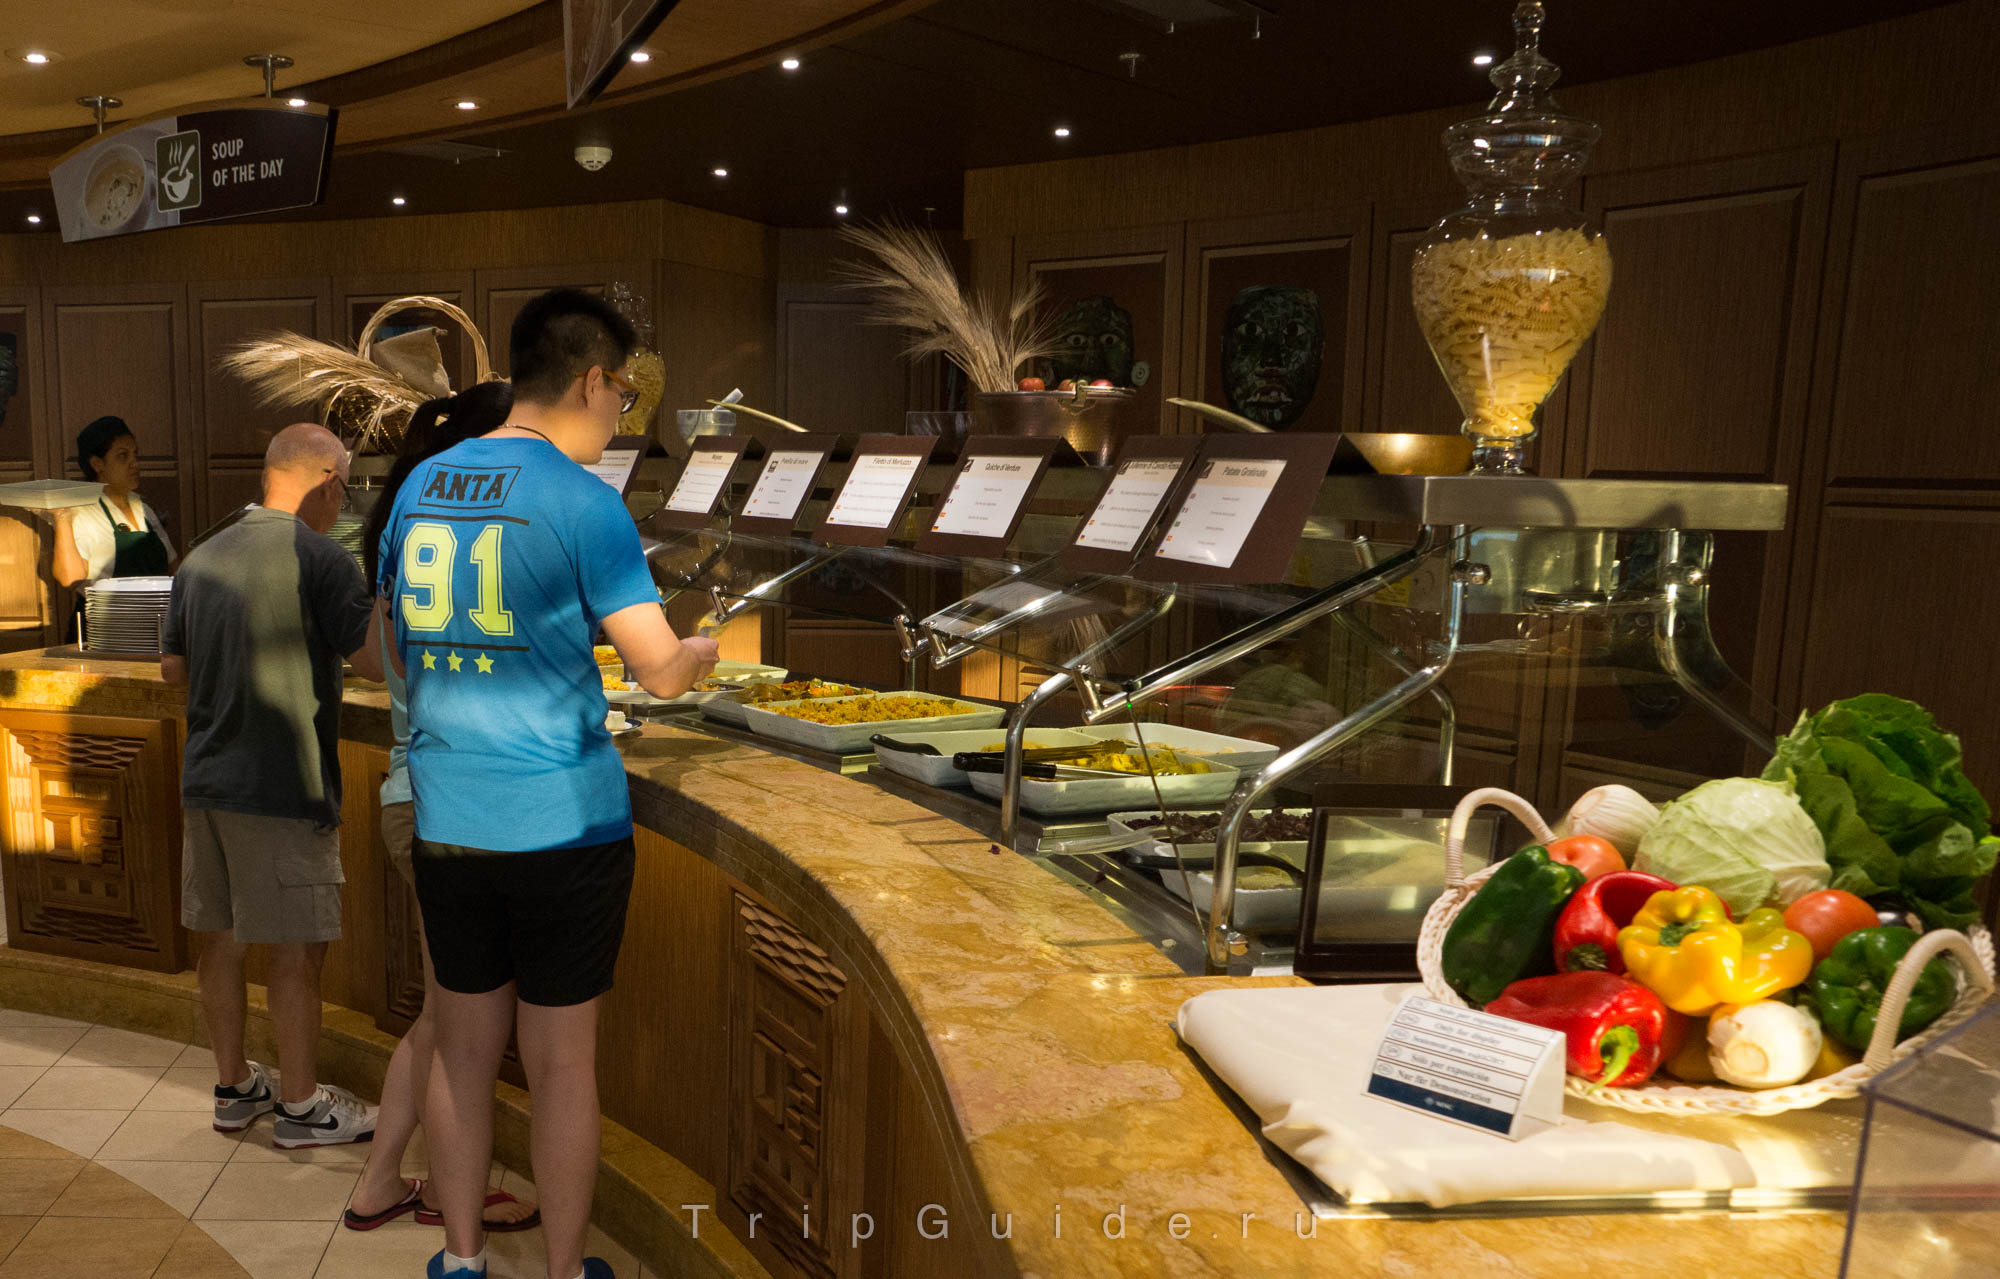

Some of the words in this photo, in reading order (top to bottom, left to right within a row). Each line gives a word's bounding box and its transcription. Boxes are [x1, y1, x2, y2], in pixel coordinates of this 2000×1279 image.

[212, 138, 244, 160] SOUP
[212, 168, 228, 187] OF
[231, 163, 255, 184] THE
[260, 158, 284, 179] DAY
[424, 471, 507, 502] ANTA
[401, 522, 514, 636] 91
[1430, 1079, 1492, 1104] Demonstration
